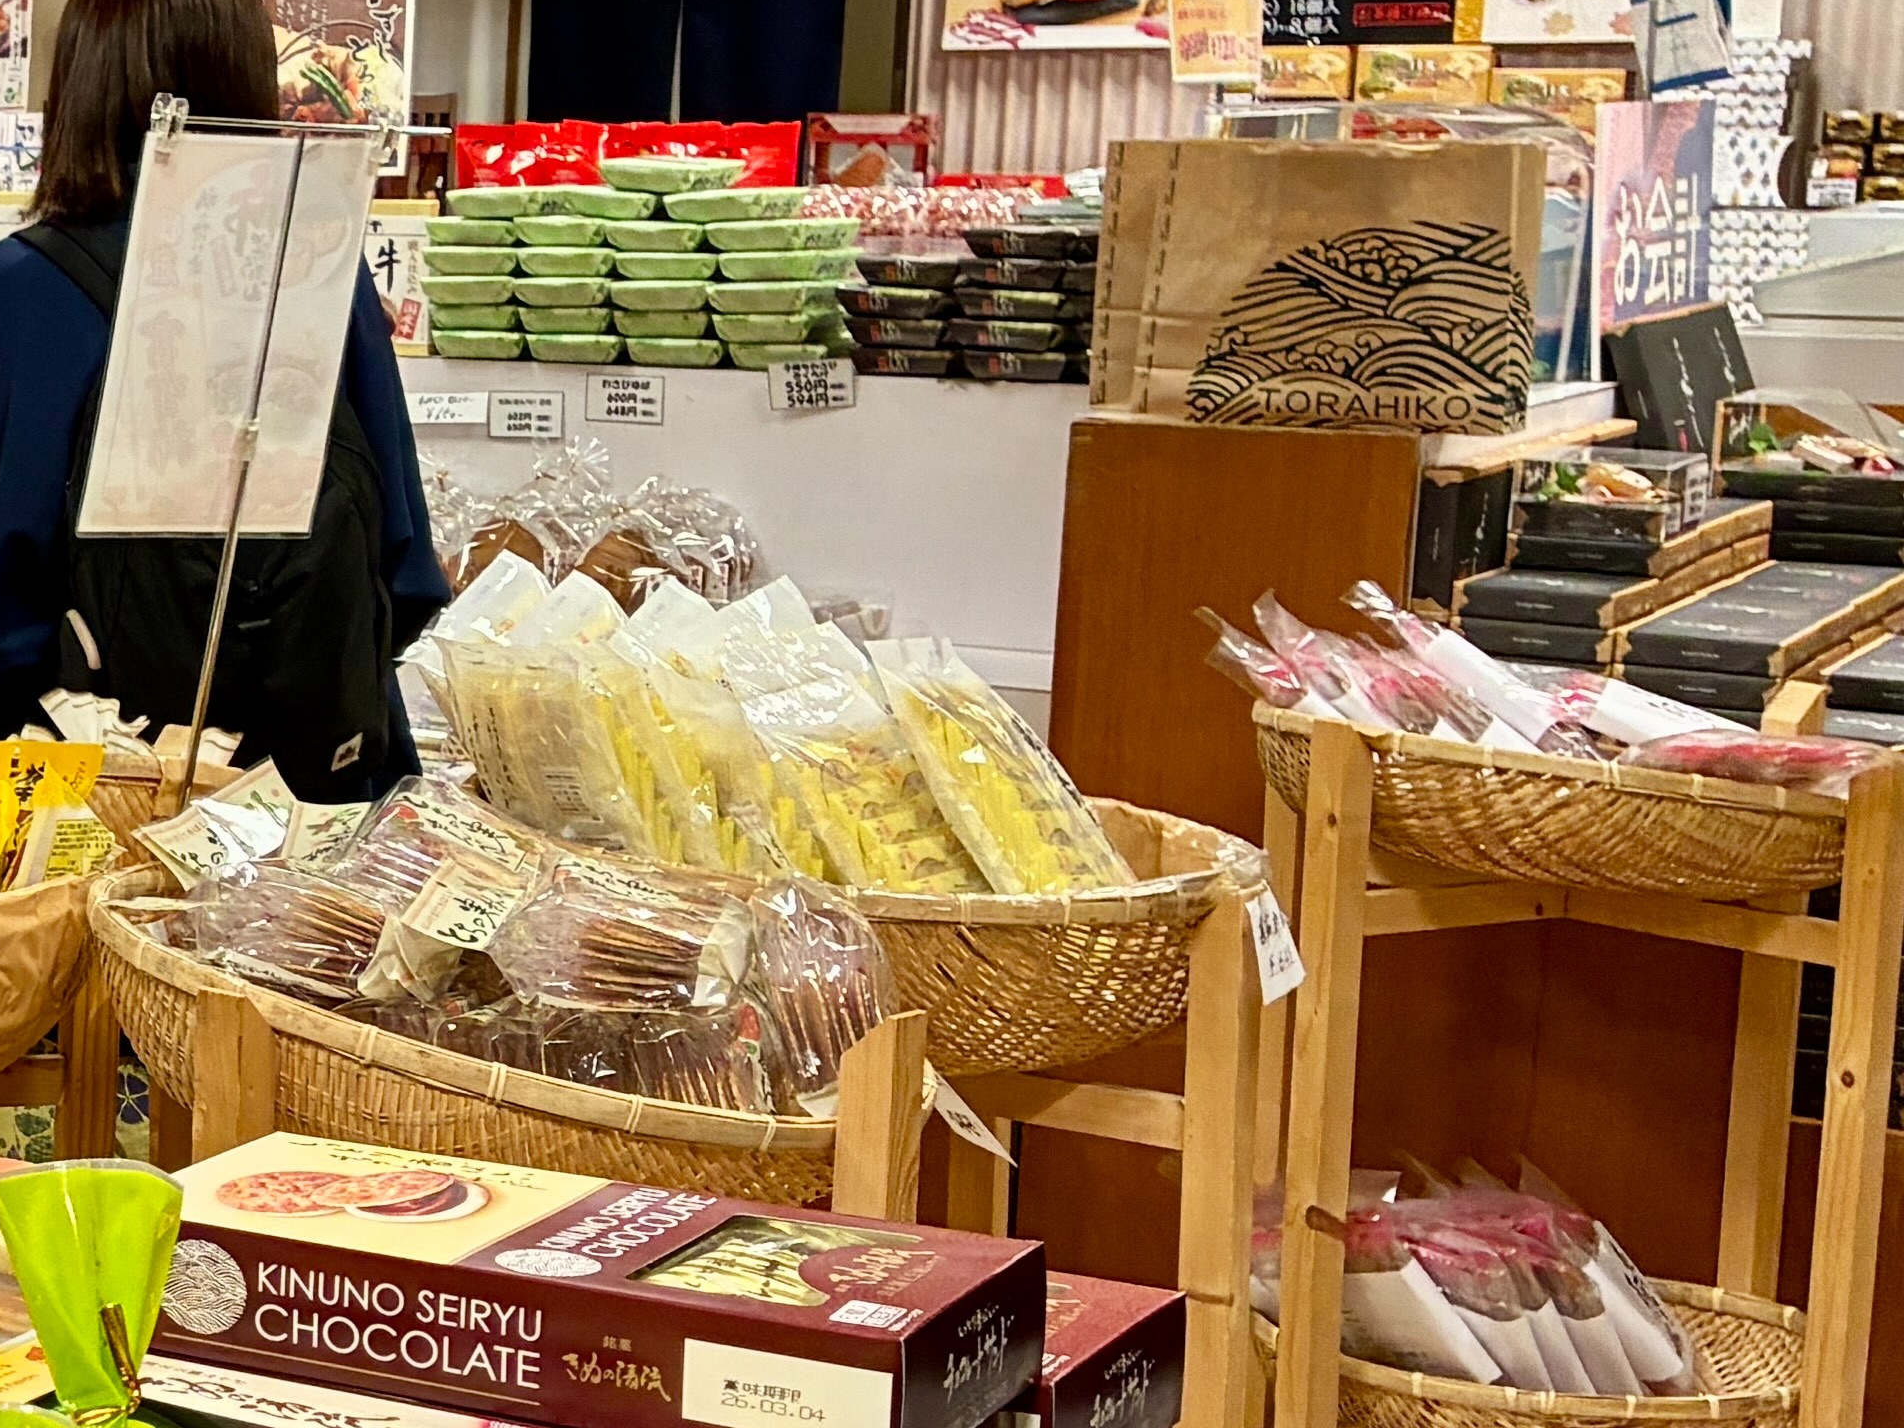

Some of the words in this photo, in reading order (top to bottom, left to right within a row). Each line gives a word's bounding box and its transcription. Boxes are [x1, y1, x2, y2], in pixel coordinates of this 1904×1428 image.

[1613, 172, 1702, 306] お会計
[1260, 388, 1472, 420] TORAHIKO
[538, 1211, 613, 1253] KINUNO
[607, 1187, 672, 1221] SEIRYU
[581, 1192, 718, 1259] CHOCOLATE
[254, 1261, 406, 1319] KINUNO
[416, 1287, 544, 1343] SEIRYU
[253, 1302, 543, 1391] CHOCOLATE
[560, 1352, 673, 1403] きぬの清流
[719, 1391, 827, 1423] 26.03.04
[721, 1377, 802, 1403] 賞味期限
